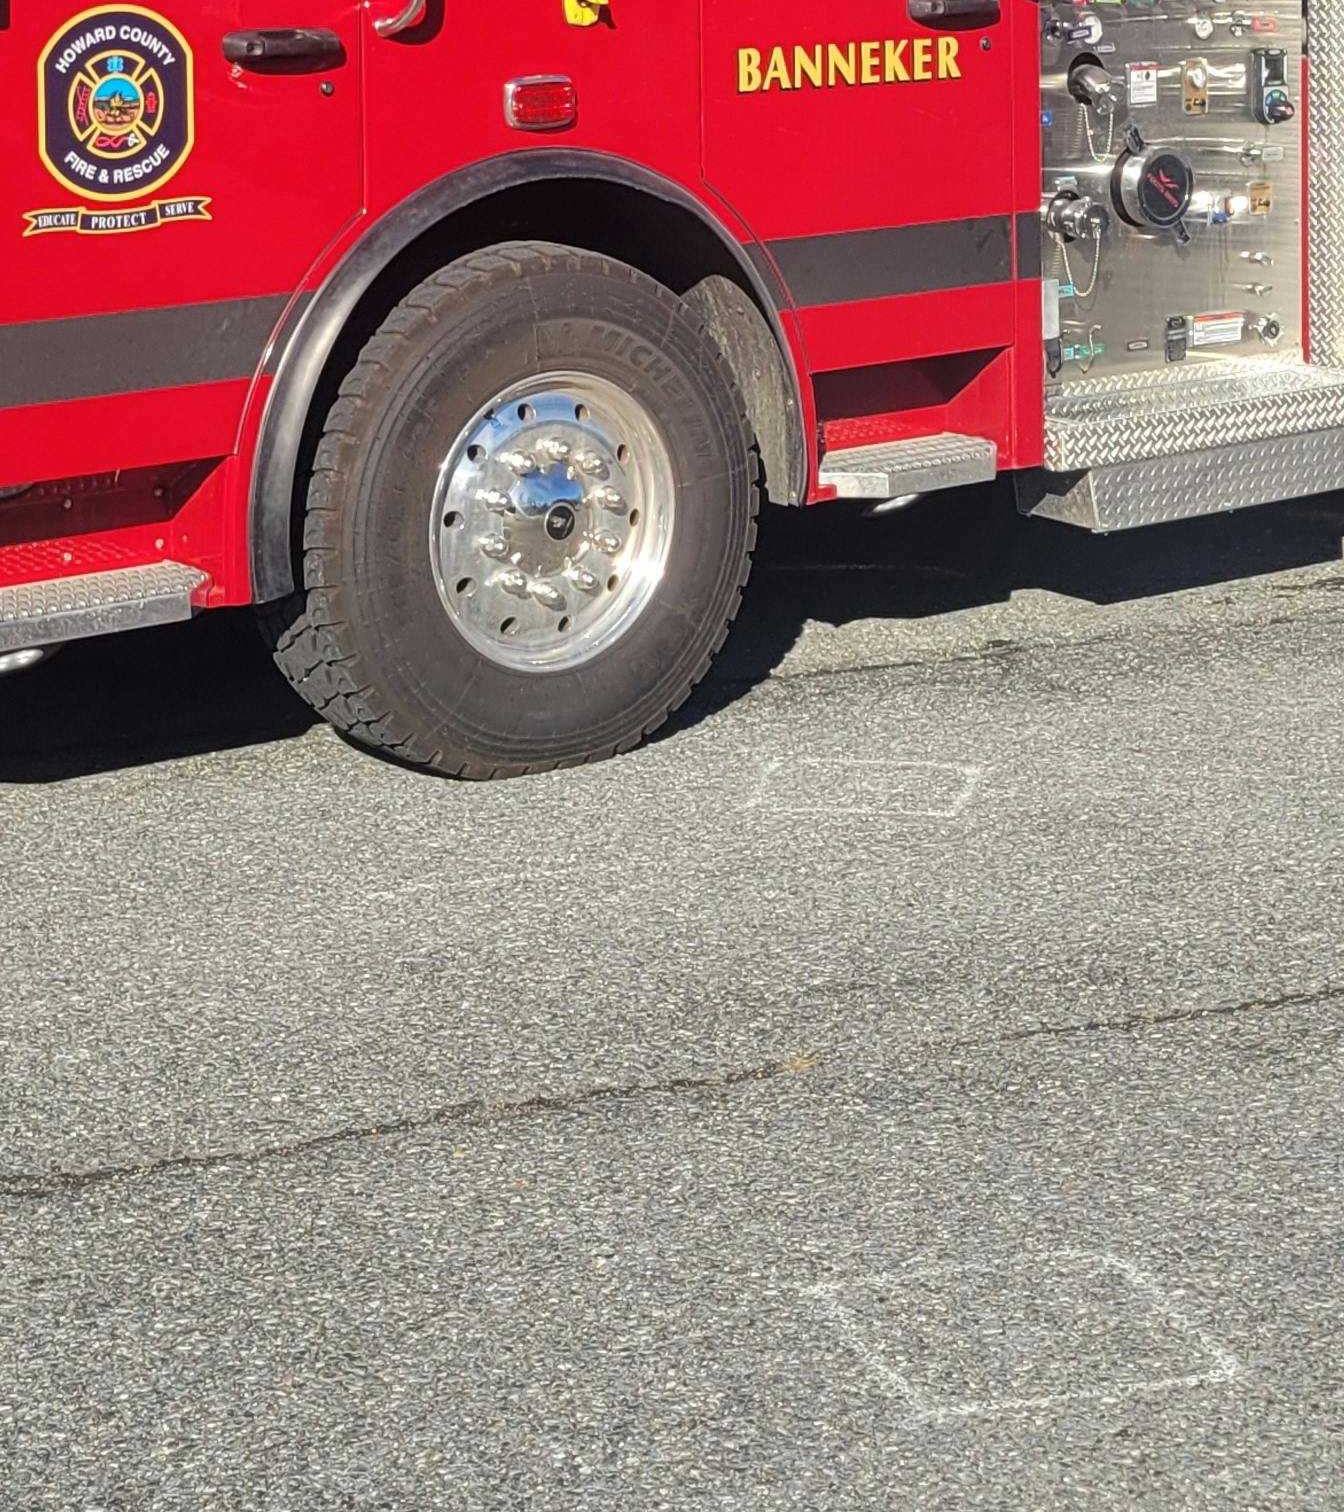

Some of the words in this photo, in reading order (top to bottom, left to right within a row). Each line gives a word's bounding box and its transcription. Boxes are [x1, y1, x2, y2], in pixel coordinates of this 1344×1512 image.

[55, 25, 116, 74] HOWARD
[119, 25, 176, 66] COUNTY
[737, 36, 962, 93] BANNEKER
[64, 150, 98, 181] FIRE
[98, 168, 109, 184] &
[113, 143, 170, 184] RESCUE
[38, 213, 76, 228] EDUCATE
[91, 212, 147, 229] PROTECT
[165, 202, 195, 216] SERVE
